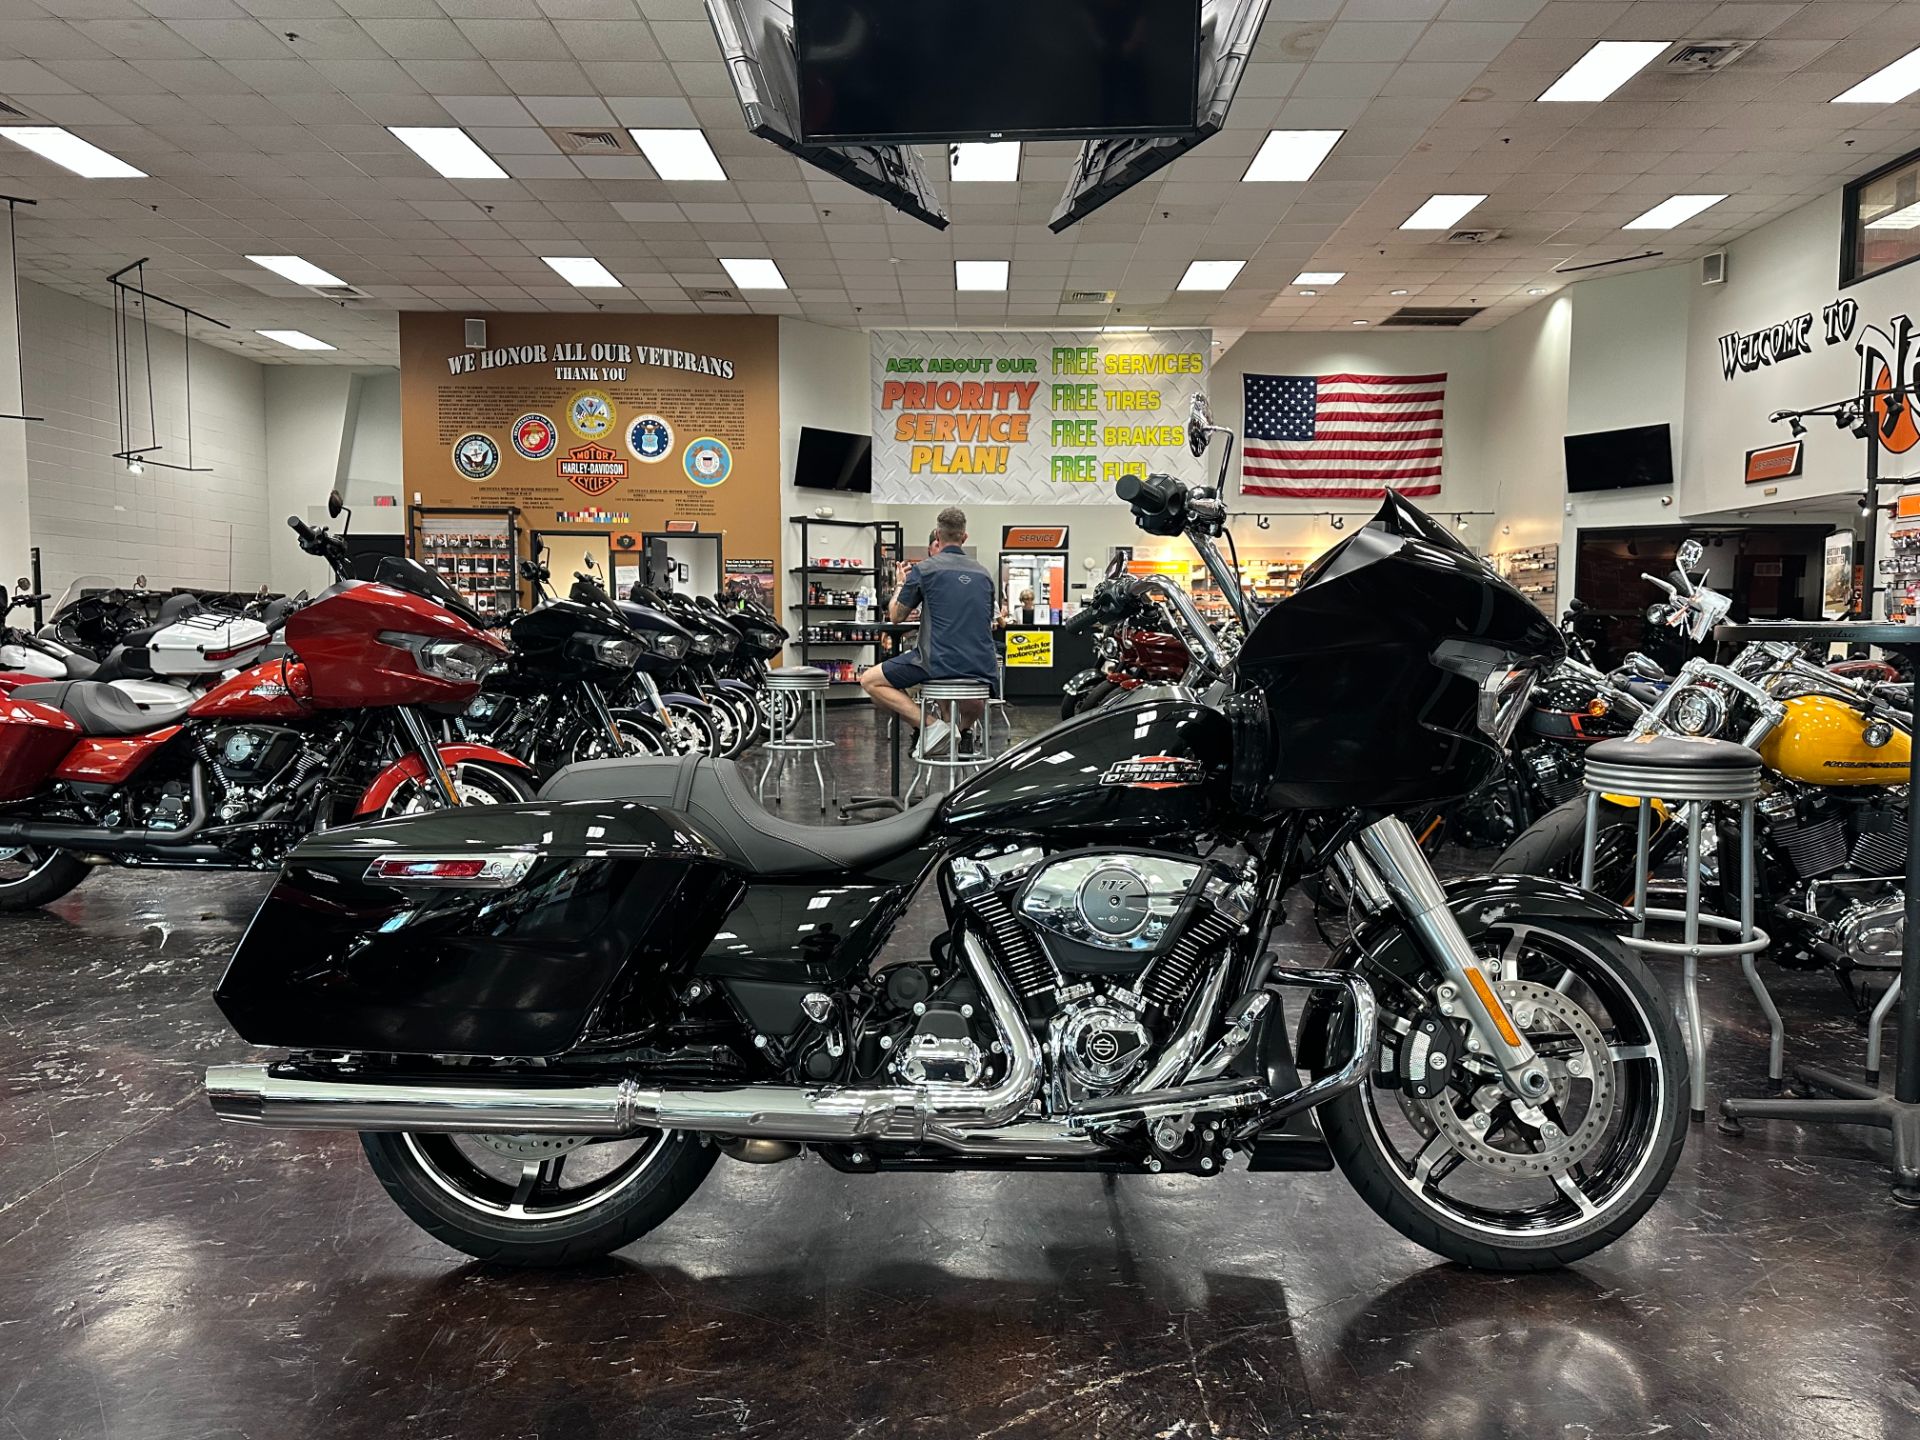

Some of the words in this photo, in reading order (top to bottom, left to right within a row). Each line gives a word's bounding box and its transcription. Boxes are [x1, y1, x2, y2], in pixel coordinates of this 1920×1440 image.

[1718, 313, 1813, 382] WELCOME
[1823, 298, 1858, 346] TO
[447, 353, 476, 376] WE
[480, 344, 548, 370] HONOR
[551, 343, 587, 362] ALL
[590, 343, 632, 363] OUR
[636, 345, 735, 380] VETERANS
[885, 358, 923, 373] ASK
[927, 358, 993, 373] ABOUT
[996, 358, 1038, 373] OUR
[1051, 347, 1099, 375] FREE
[1103, 352, 1203, 375] SERVICES
[555, 367, 599, 381] THANK
[601, 367, 627, 381] YOU
[881, 380, 1040, 411] PRIORITY
[1051, 383, 1098, 411] FREE
[1103, 390, 1162, 411] TIRES
[895, 413, 1031, 442] SERVICE
[1051, 419, 1097, 447] FREE
[1103, 425, 1185, 447] BRAKES
[576, 448, 609, 460] MOTOR
[910, 445, 1009, 475] PLAN!
[562, 462, 624, 475] HARLEY-DAVIDSON
[1050, 455, 1097, 483] FREE
[1103, 462, 1147, 482] FUEL
[577, 476, 610, 491] CYCLES
[1018, 534, 1056, 542] SERVICE
[1008, 648, 1051, 659] motorcycles
[1017, 643, 1039, 651] watch
[1098, 880, 1134, 891] 117
